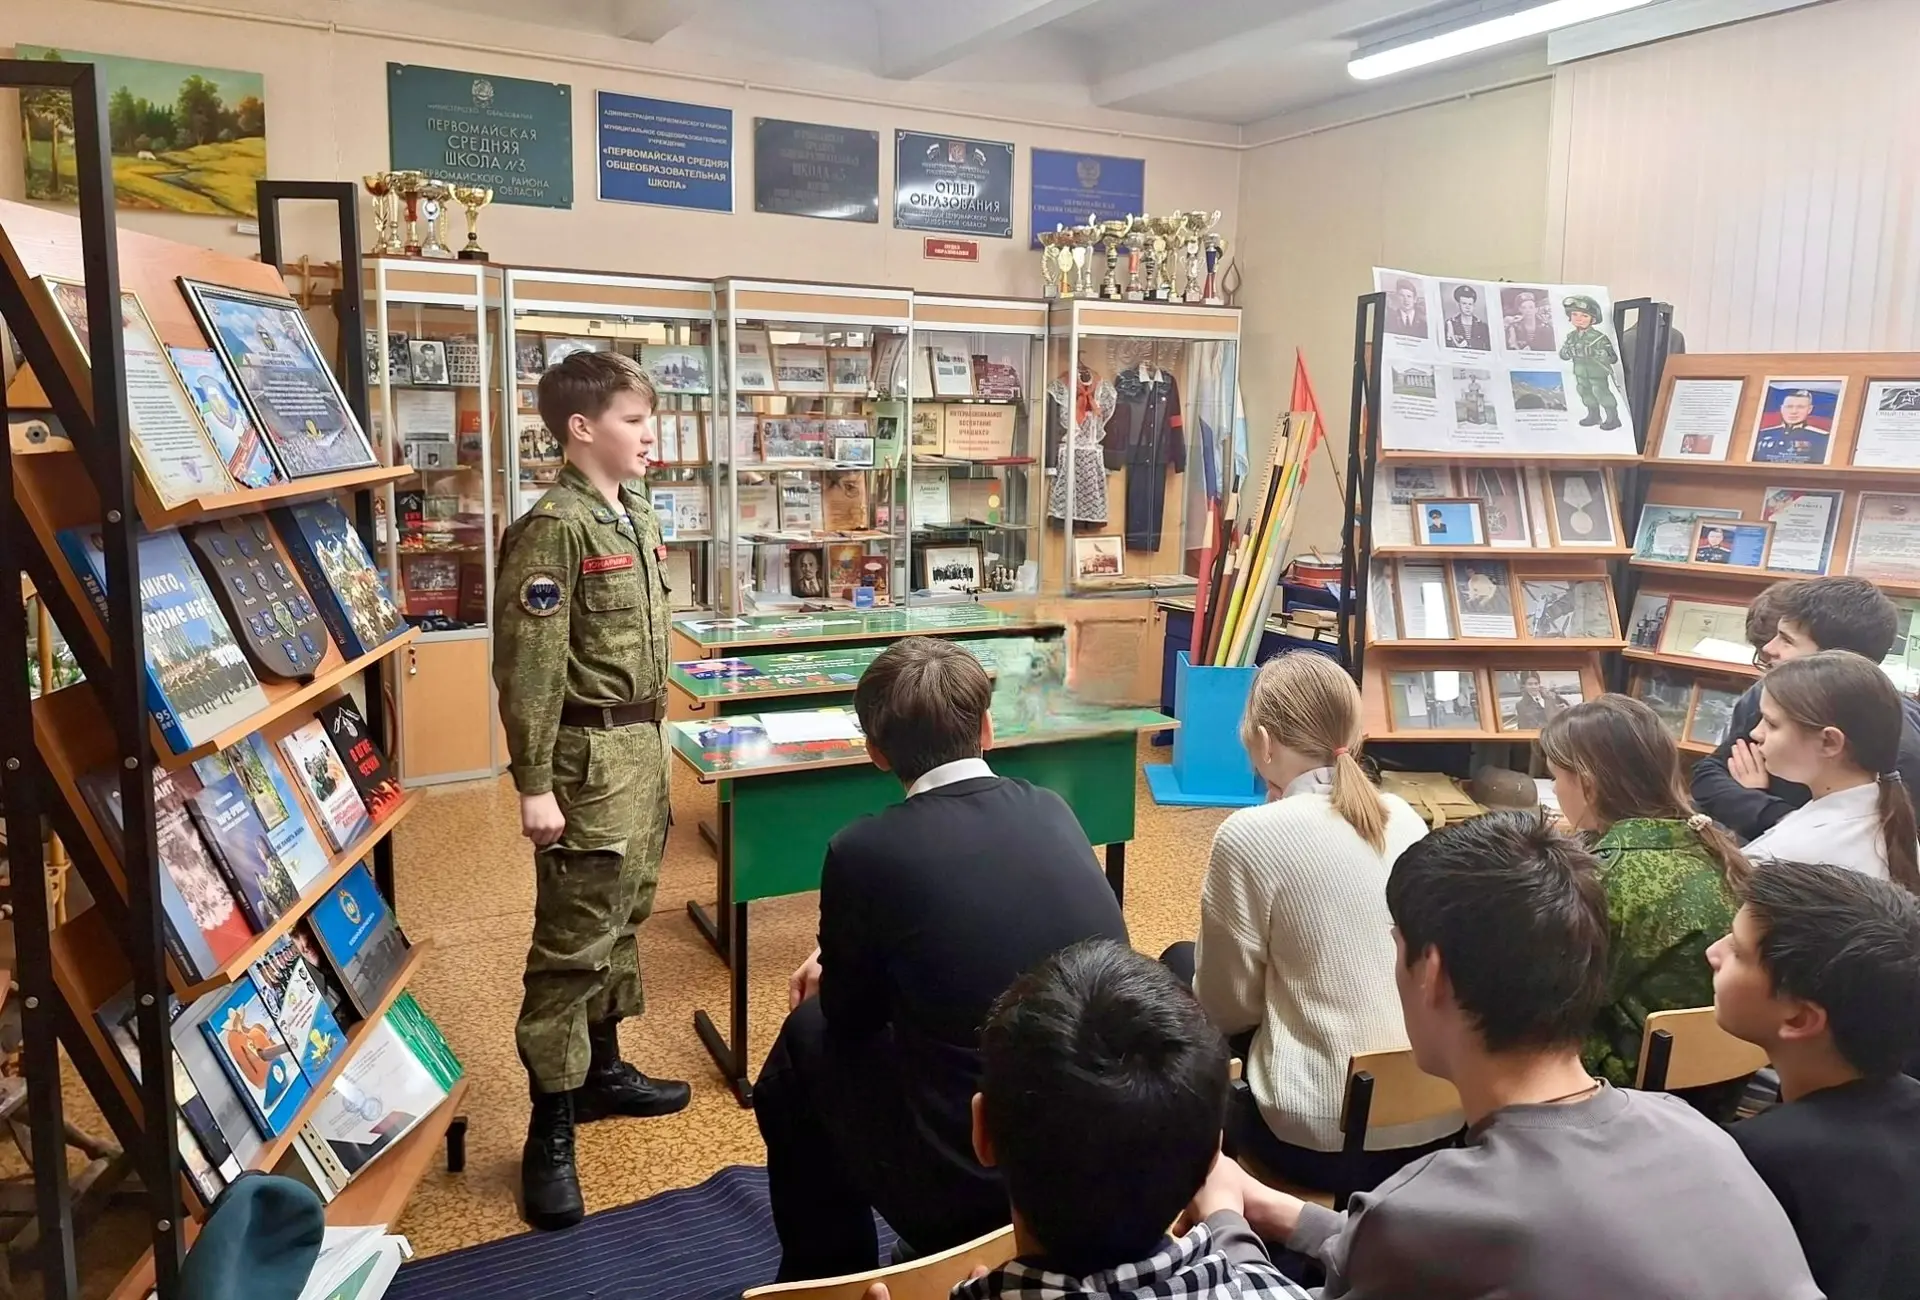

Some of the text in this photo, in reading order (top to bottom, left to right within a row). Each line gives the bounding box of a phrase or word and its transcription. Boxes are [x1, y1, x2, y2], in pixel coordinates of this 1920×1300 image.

[427, 117, 538, 141] ПЕРВОМАЙСКАЯ
[447, 135, 520, 155] СРЕДНЯЯ
[445, 151, 502, 170] ШКОЛА
[603, 146, 730, 169] «ПЕРВОМАЙСКАЯ СРЕДНЯЯ
[606, 159, 727, 182] ОБЩЕОБРАЗОВАТЕЛЬНАЯ
[499, 185, 544, 198] ОБЛАСТИ
[648, 178, 688, 190] ШКОЛА»
[935, 180, 976, 197] ОТДЕЛ
[909, 192, 1001, 213] ОБРАЗОВАНИЯ
[155, 709, 171, 723] 95
